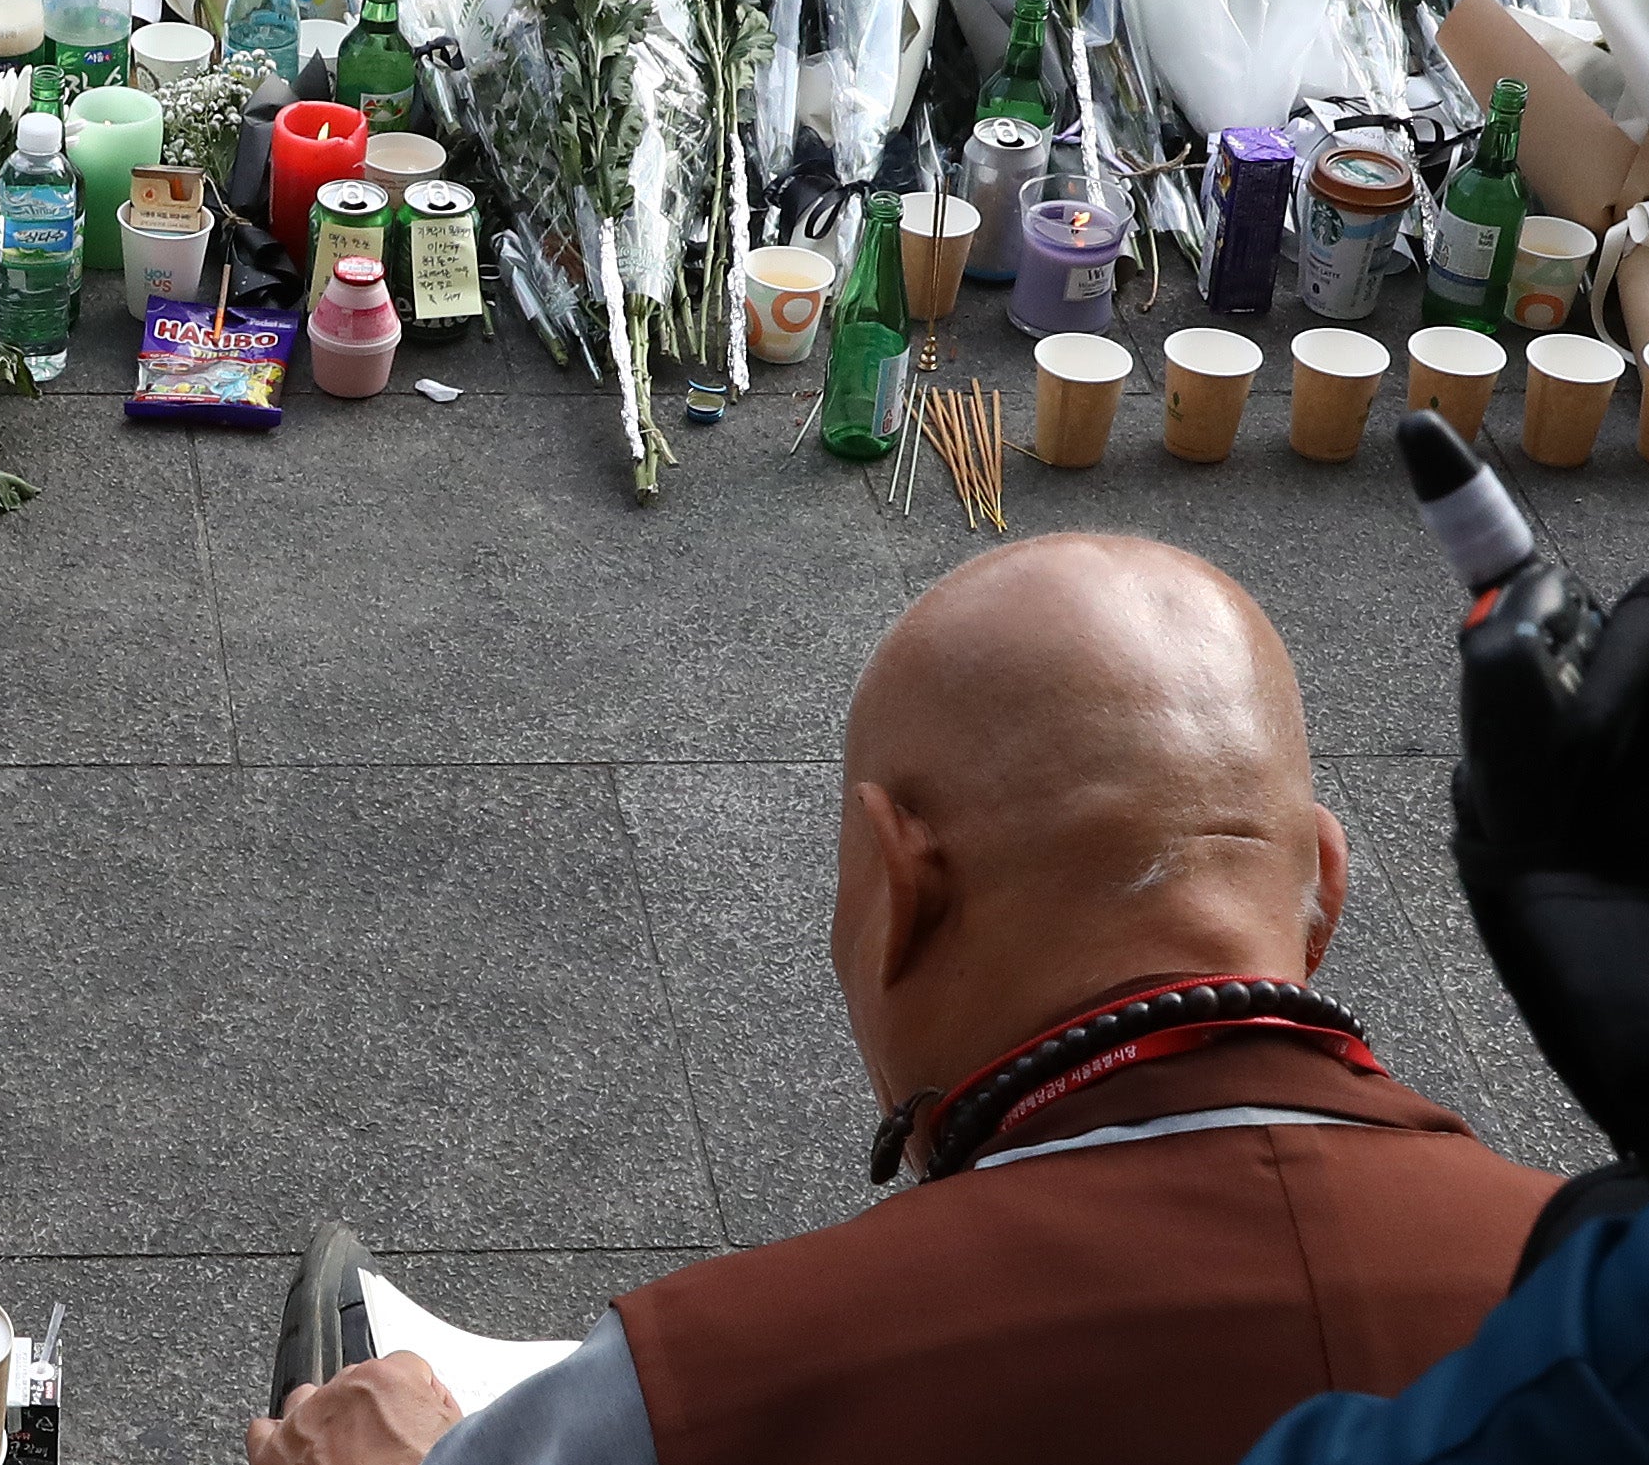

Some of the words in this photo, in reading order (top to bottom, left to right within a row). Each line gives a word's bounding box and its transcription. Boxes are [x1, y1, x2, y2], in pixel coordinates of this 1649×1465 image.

[84, 50, 105, 64] 서울
[24, 230, 64, 244] 삼다수
[143, 267, 173, 282] you
[154, 318, 279, 350] HARIBO
